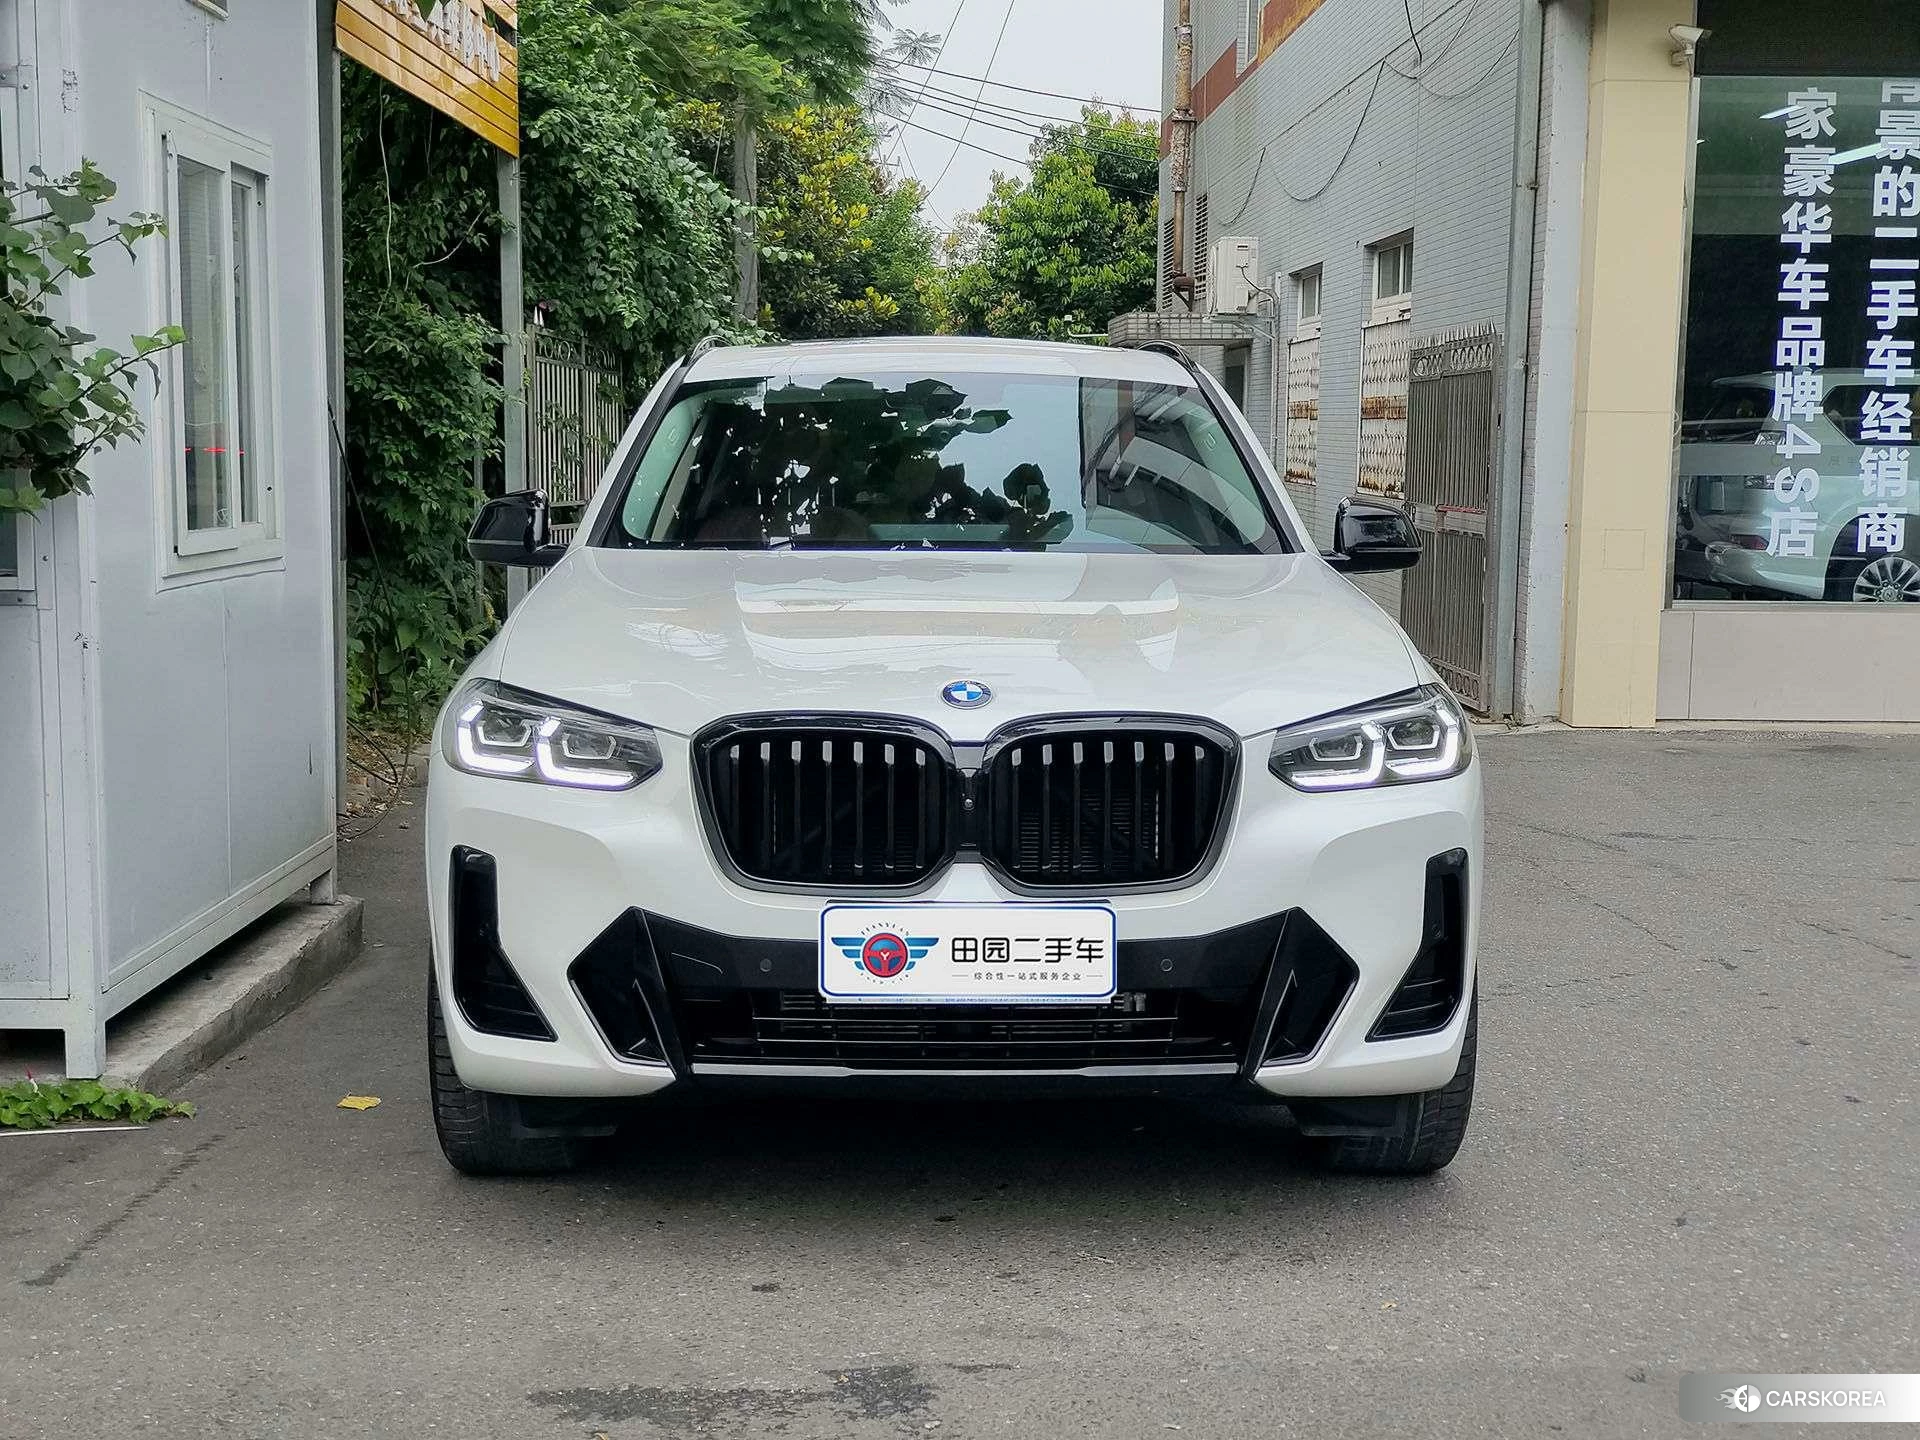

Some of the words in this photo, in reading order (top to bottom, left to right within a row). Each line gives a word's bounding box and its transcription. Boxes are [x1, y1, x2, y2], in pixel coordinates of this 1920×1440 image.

[1766, 87, 1837, 557] 家豪华车品牌4S店
[951, 937, 1105, 963] 田园二手车
